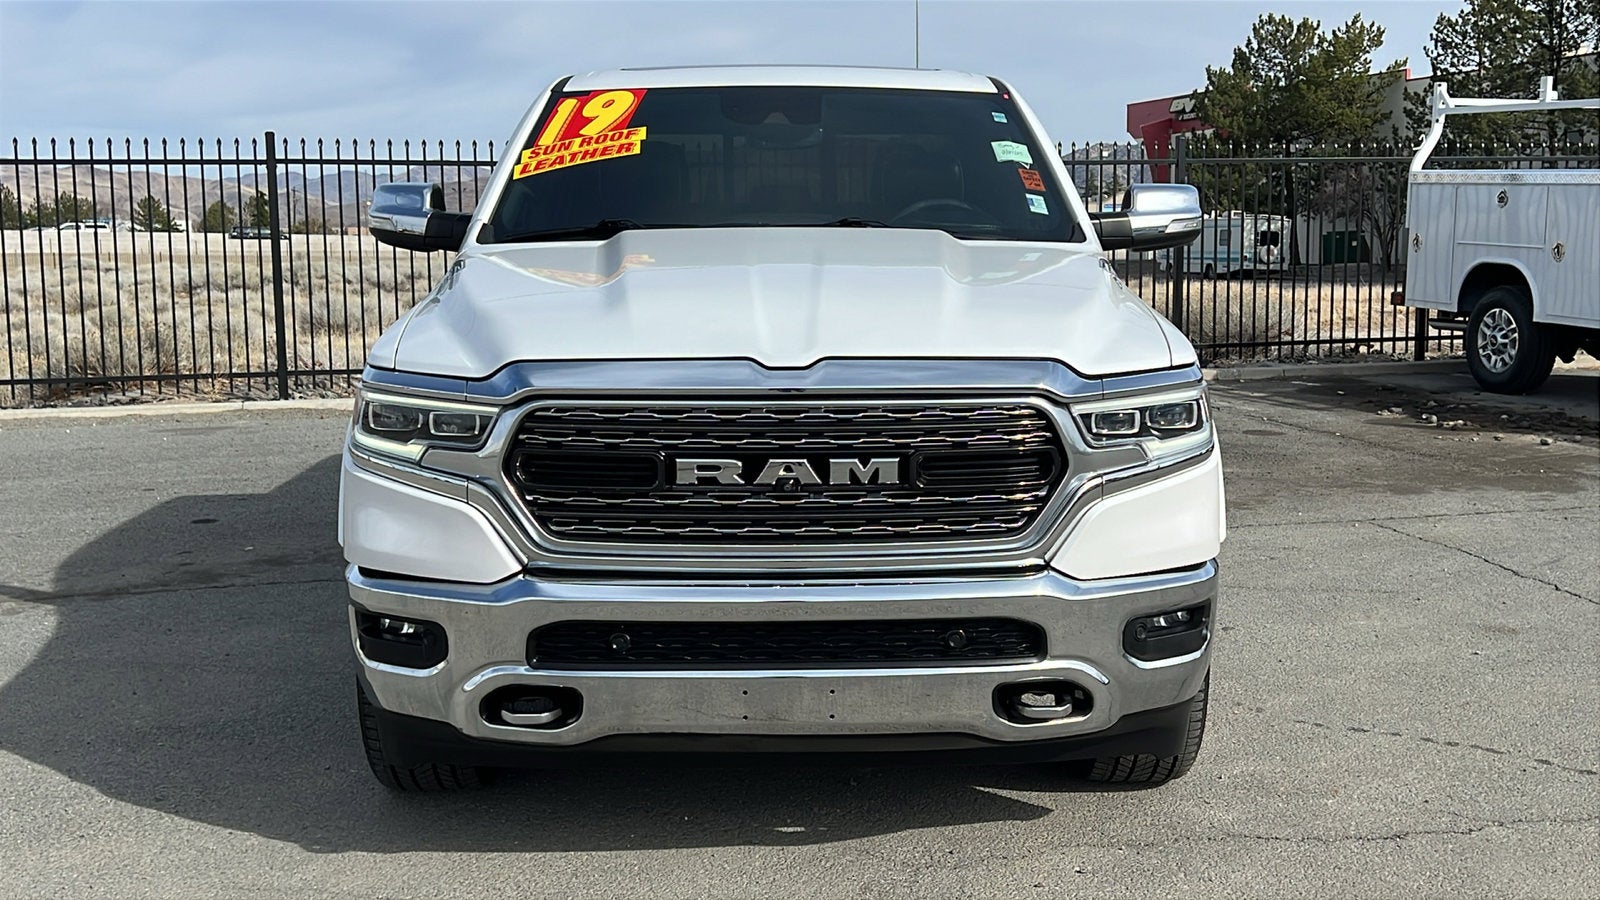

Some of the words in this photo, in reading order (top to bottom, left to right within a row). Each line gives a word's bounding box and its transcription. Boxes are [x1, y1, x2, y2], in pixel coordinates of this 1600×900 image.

[538, 90, 637, 146] 19
[519, 142, 637, 176] LEATHER
[527, 141, 575, 160] SUN
[578, 128, 641, 148] ROOF
[675, 458, 900, 485] RAM
